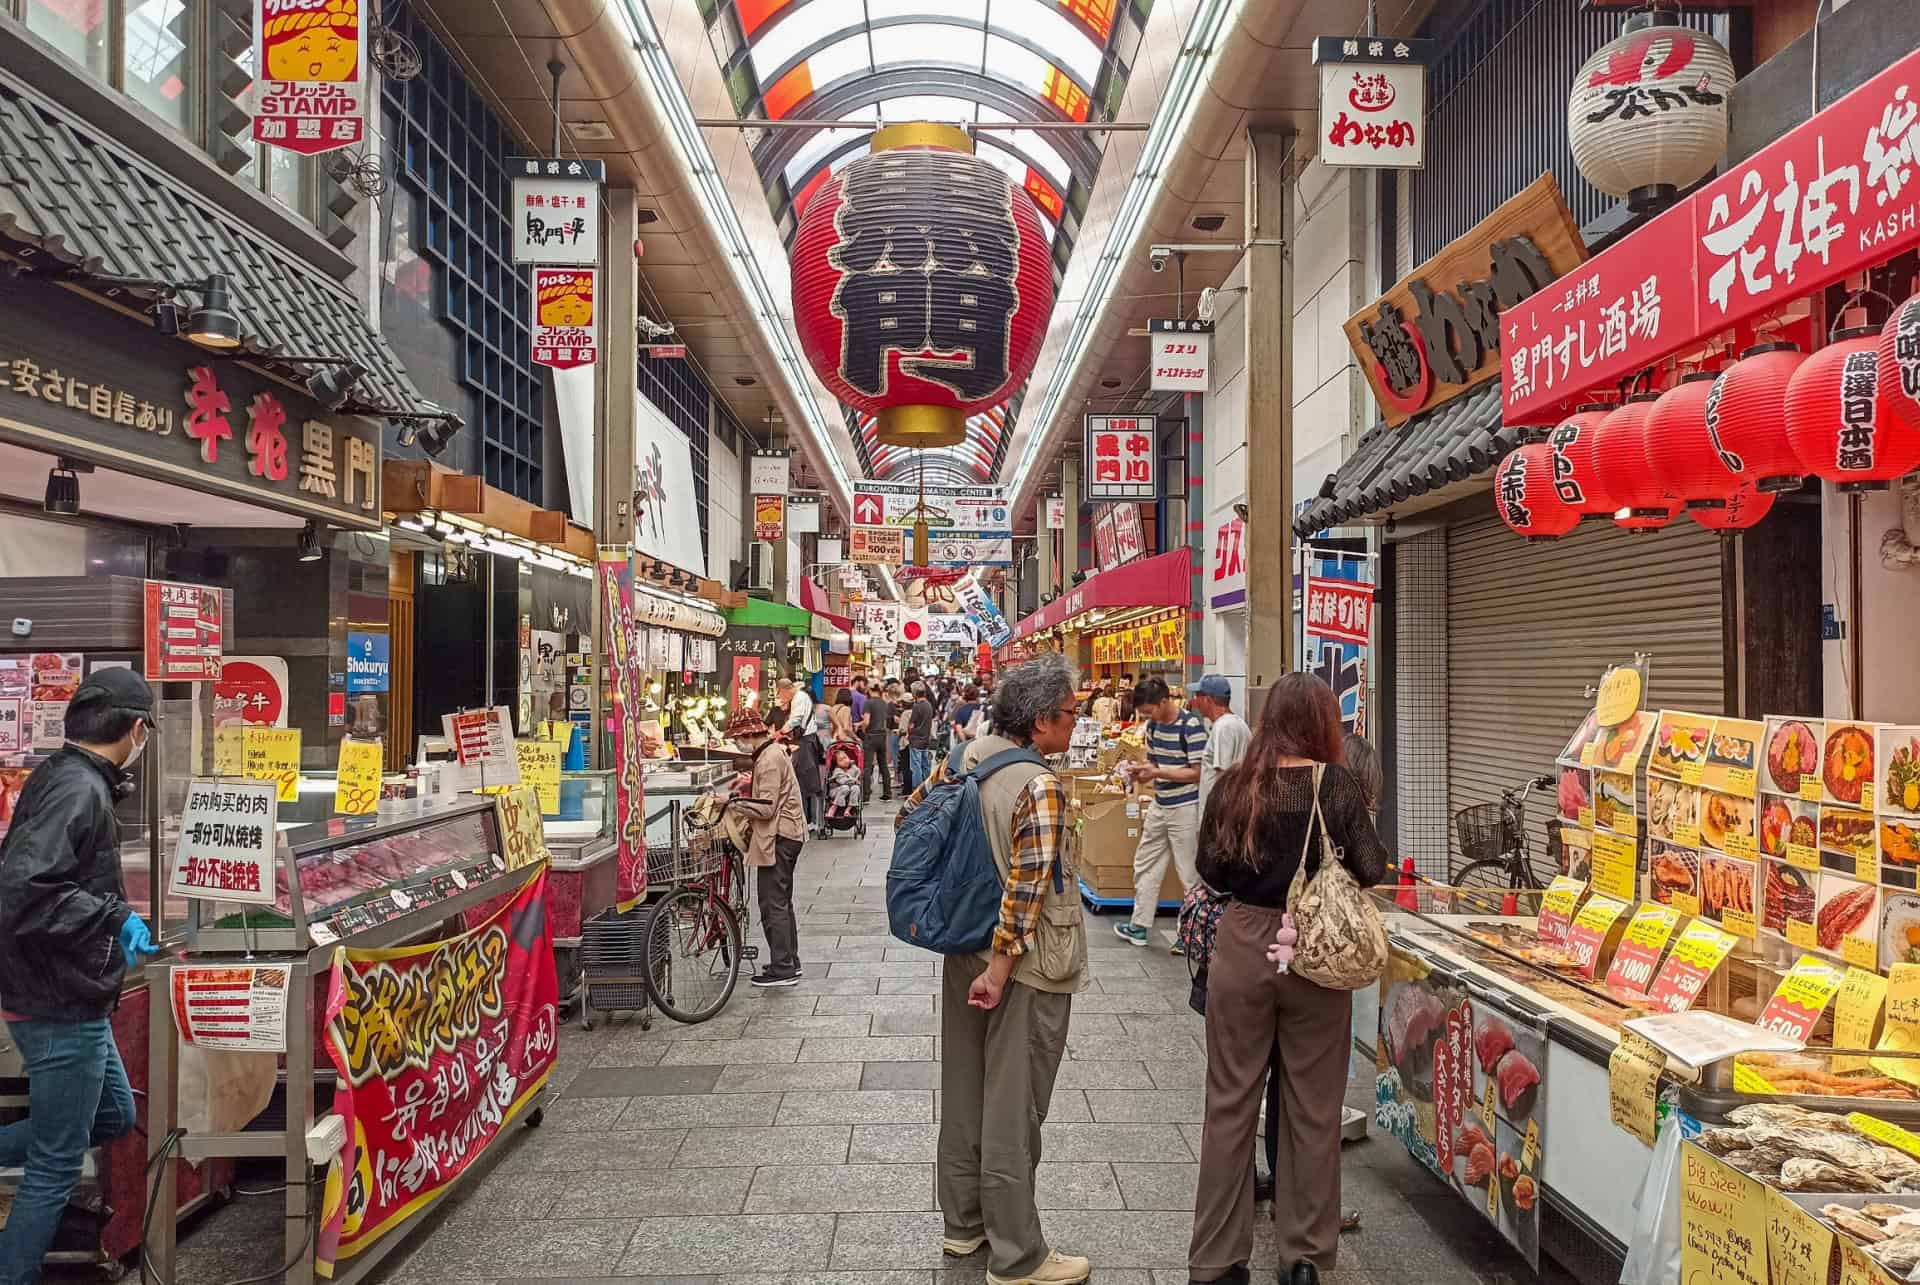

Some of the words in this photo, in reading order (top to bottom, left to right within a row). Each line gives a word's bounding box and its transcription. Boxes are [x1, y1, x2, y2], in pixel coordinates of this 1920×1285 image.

[269, 82, 346, 98] フレッシュ
[261, 97, 357, 116] STAMP
[260, 118, 357, 140] 加盟店
[1329, 112, 1415, 150] わなか
[1860, 209, 1920, 252] KASH
[1509, 312, 1539, 343] すし
[1552, 273, 1600, 313] 一品料理
[537, 336, 592, 347] STAMP
[1164, 344, 1198, 355] クスリ
[1509, 275, 1662, 405] 黒門すし酒場
[1837, 350, 1879, 470] 厳選日本酒
[299, 419, 376, 511] 黒門
[1552, 423, 1586, 504] 中トロ
[903, 486, 956, 497] INFOMATION
[1502, 453, 1531, 527] 上赤身
[868, 545, 886, 554] 500
[1213, 517, 1246, 582] クス
[347, 656, 389, 676] Shokuryu
[824, 666, 849, 676] KOBE
[824, 677, 849, 687] BEEF
[190, 791, 268, 814] 店内购买的肉
